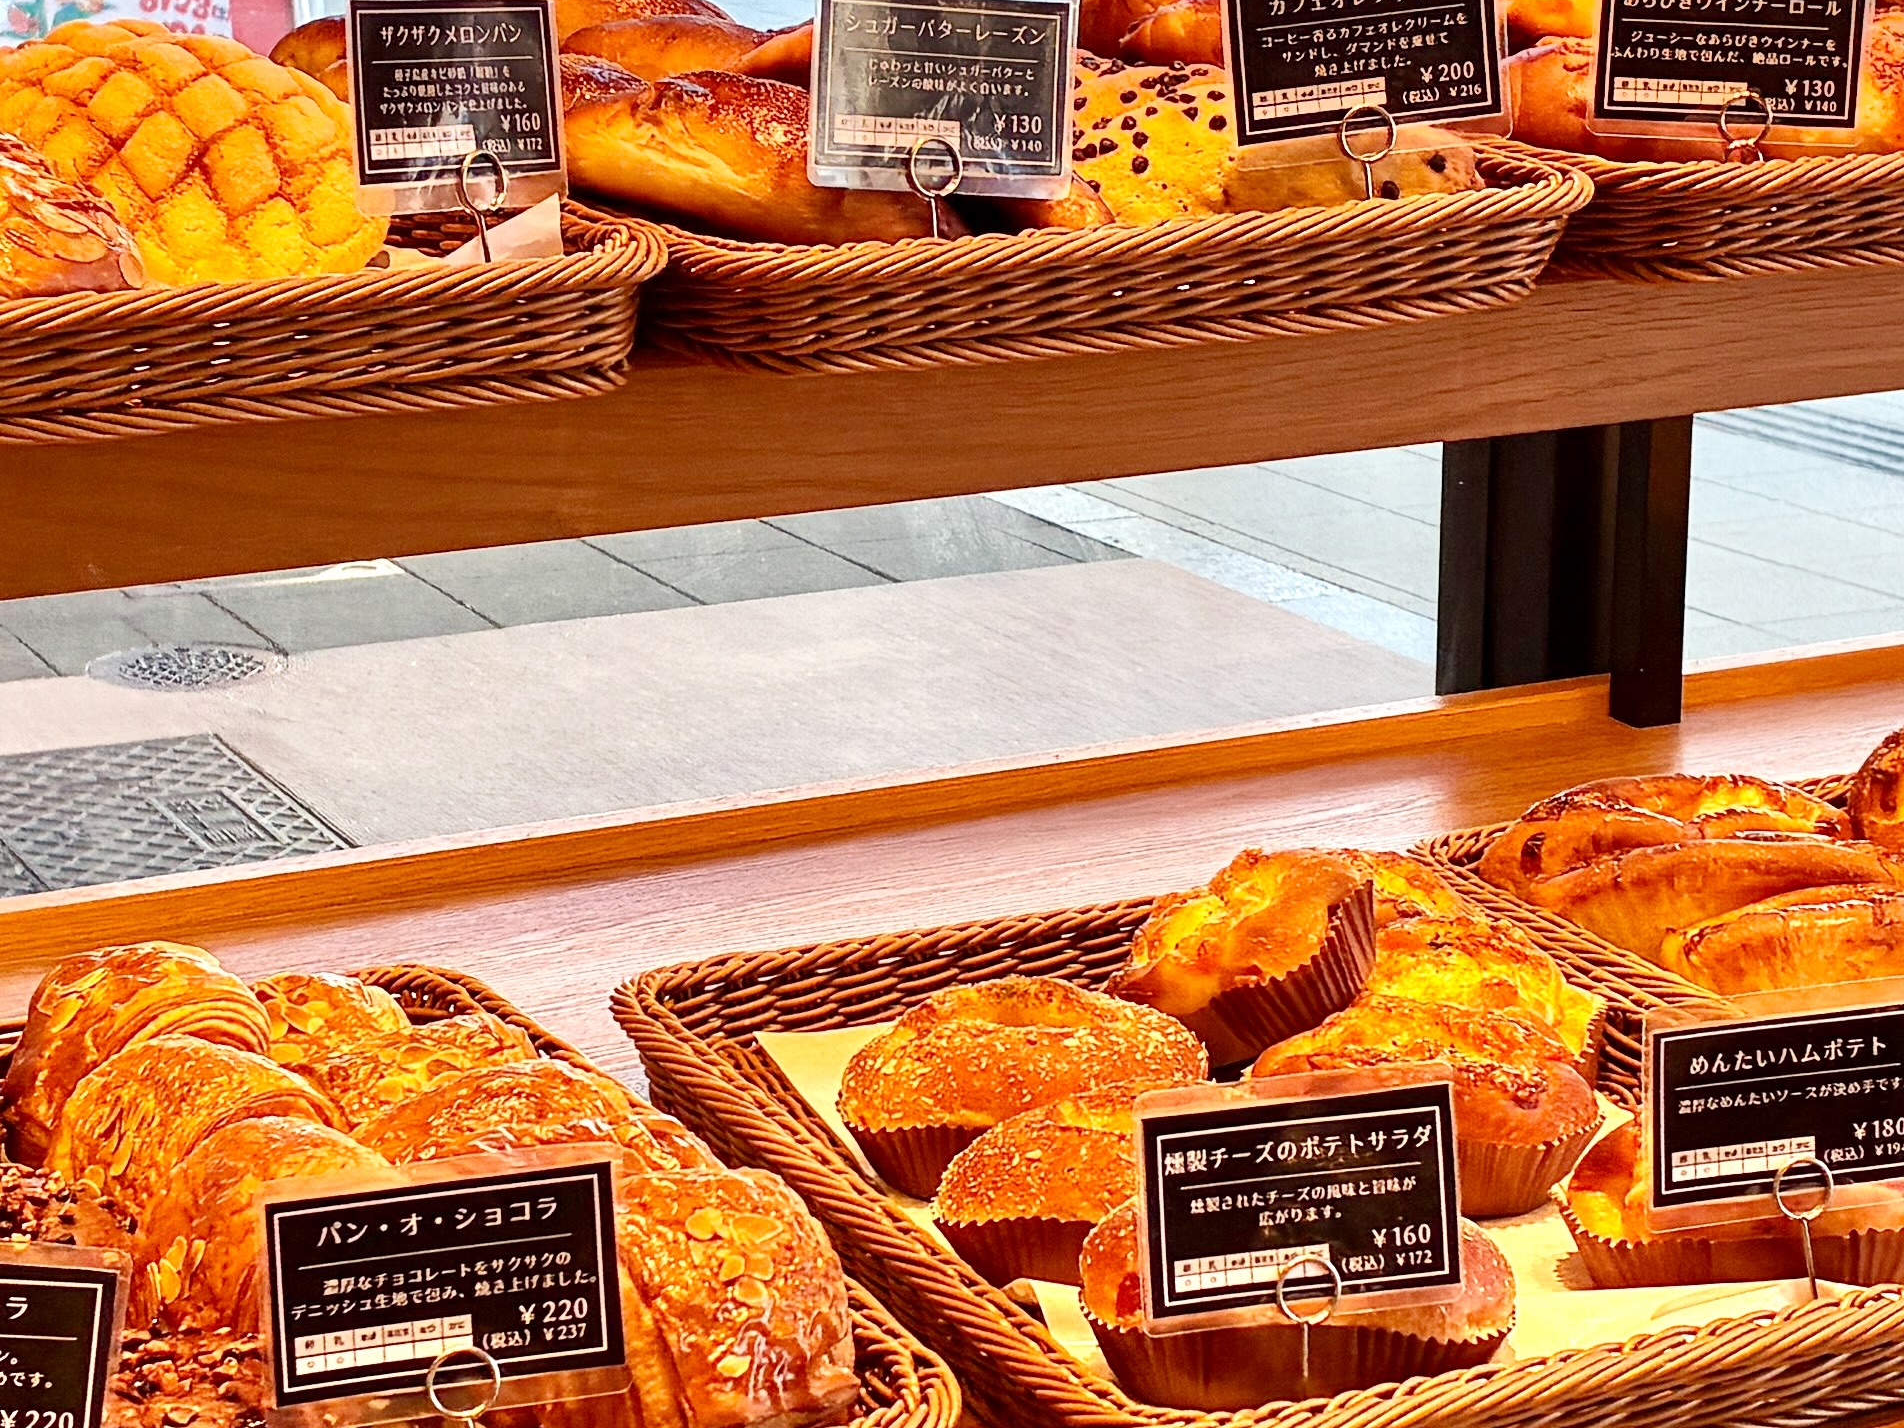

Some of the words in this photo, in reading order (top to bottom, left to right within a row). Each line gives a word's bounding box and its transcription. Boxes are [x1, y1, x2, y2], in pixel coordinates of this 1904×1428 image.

[379, 23, 522, 47] ザクザクメロンパン
[846, 16, 1046, 45] シュガーバターレーズン
[1631, 30, 1837, 52] ジューシーなあらびきウインナーを
[1420, 60, 1474, 84] ¥200
[1448, 83, 1482, 98] ¥216
[1784, 79, 1835, 97] ¥130
[1804, 100, 1837, 112] ¥140
[501, 113, 541, 133] ¥160
[994, 114, 1042, 134] ¥130
[1010, 138, 1043, 152] ¥140
[1689, 1035, 1887, 1075] めんたいハムポテト
[1164, 1124, 1433, 1176] 燻製チーズのポテトサラダ
[316, 1196, 558, 1247] パン・オ・ショコラ
[1259, 1205, 1342, 1227] 広がります。
[1371, 1223, 1432, 1249] ¥160
[1395, 1250, 1433, 1266] ¥172
[323, 1251, 571, 1297] 濃厚なチョコレートをサクサクの
[518, 1297, 588, 1326] ¥220
[543, 1323, 586, 1342] ¥237
